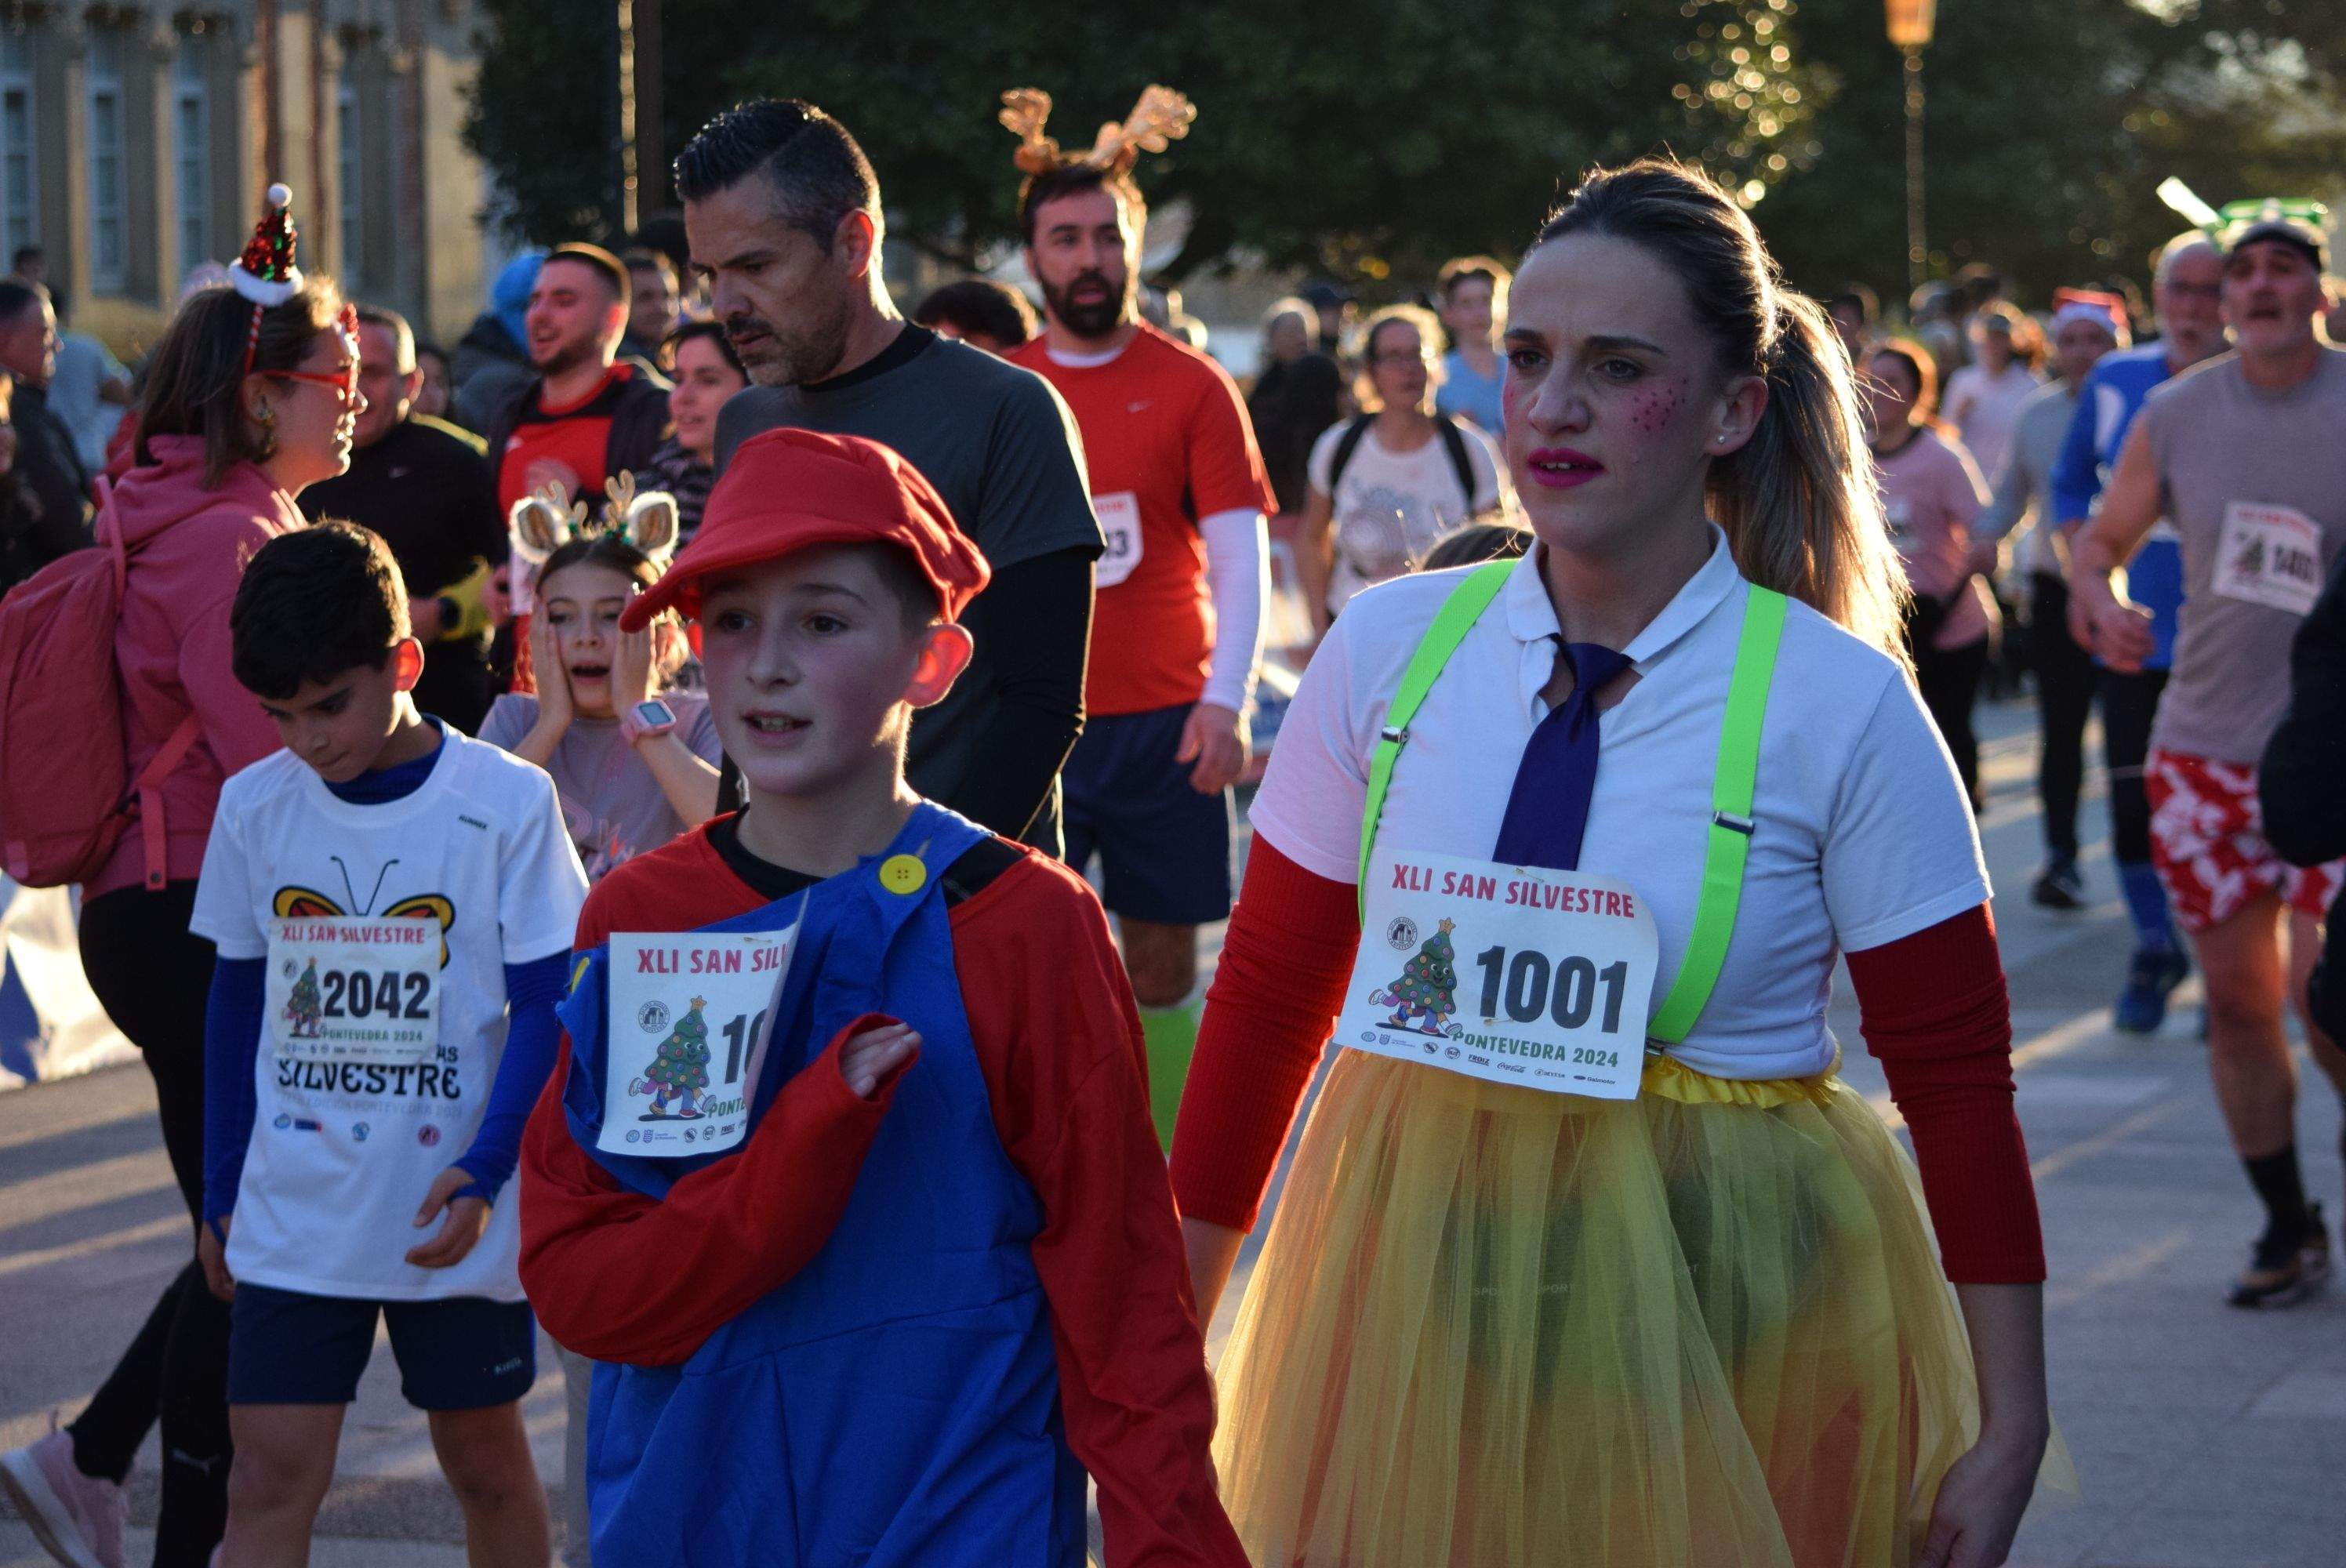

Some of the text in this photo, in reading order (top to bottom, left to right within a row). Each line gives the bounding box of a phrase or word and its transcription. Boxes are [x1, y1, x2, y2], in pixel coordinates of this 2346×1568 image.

[1392, 864, 1635, 918] XLI SAN SILVESTRE
[282, 924, 425, 944] XLI SAN SILVESTRE
[637, 949, 679, 973] XLI
[690, 949, 742, 973] SAN
[323, 970, 430, 1018] 2042
[1476, 945, 1629, 1034] 1001
[394, 1030, 423, 1041] 2024
[1452, 1032, 1618, 1067] PONTEVEDRA 2024
